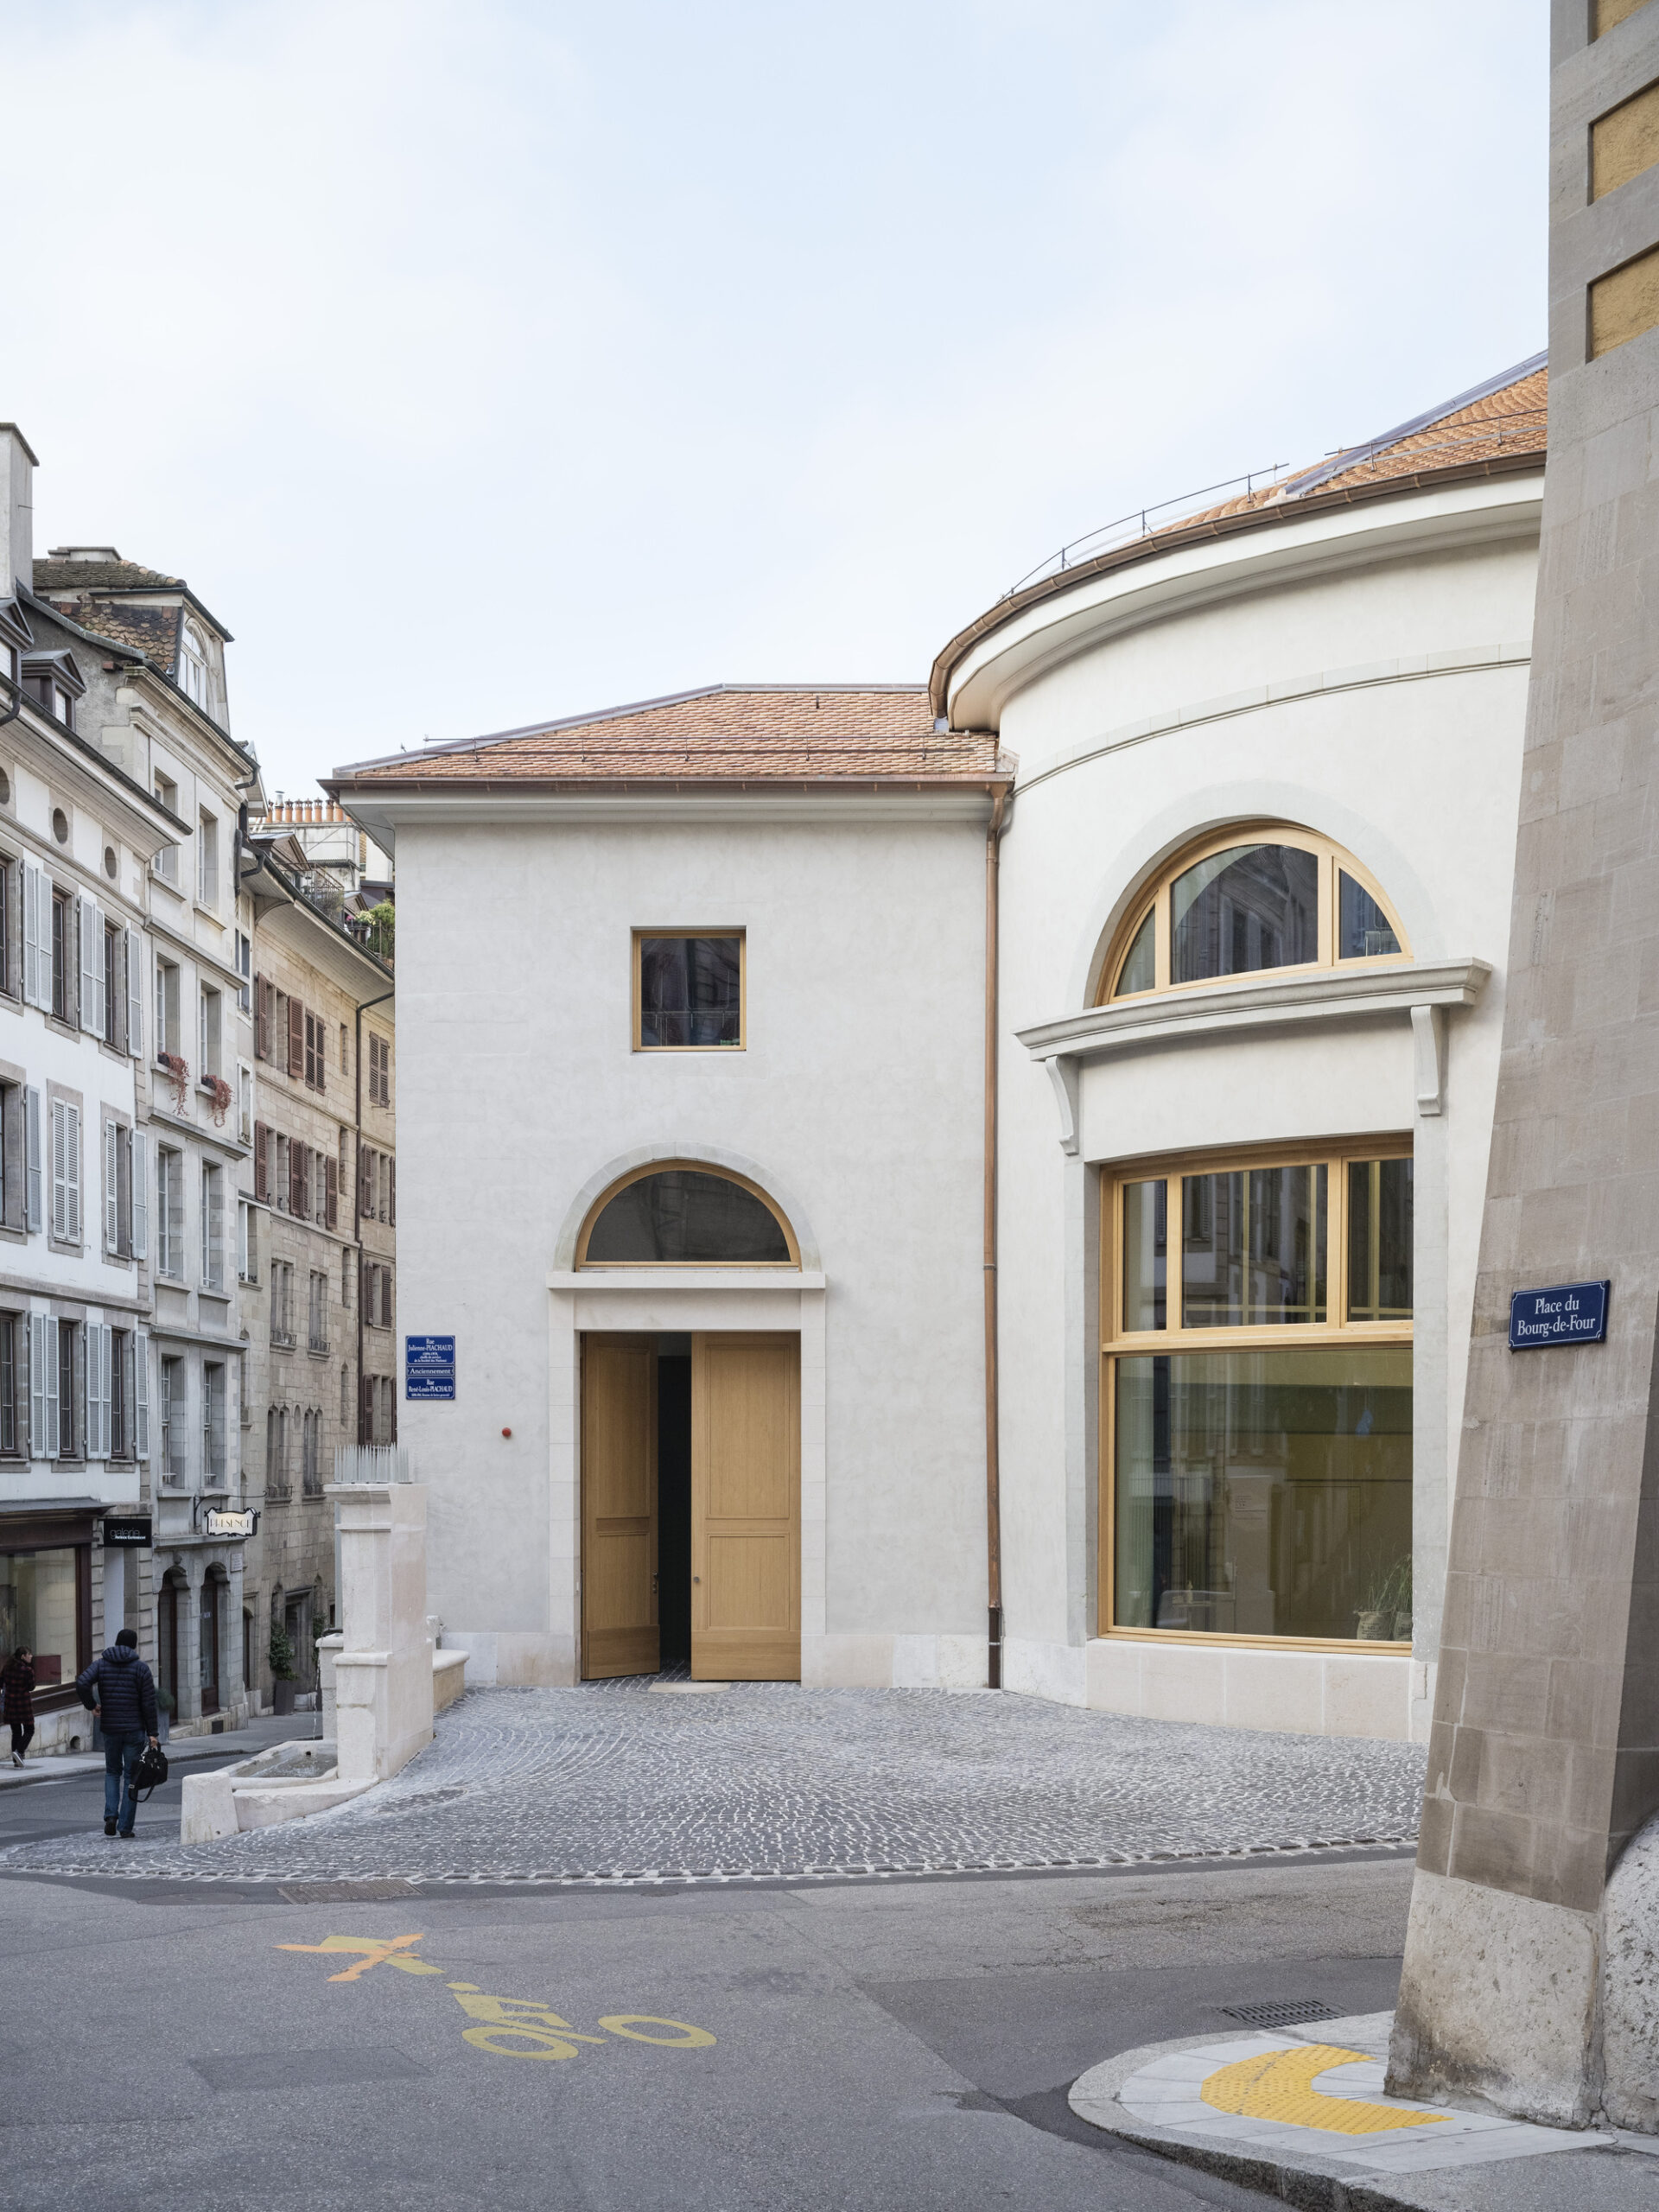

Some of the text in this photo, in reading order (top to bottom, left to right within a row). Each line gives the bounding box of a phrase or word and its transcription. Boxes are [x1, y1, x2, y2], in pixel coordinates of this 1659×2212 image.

[1535, 1294, 1580, 1314] Place du
[1517, 1314, 1595, 1338] Bourg-de-Four
[210, 1519, 250, 1528] PRESENCE
[110, 1528, 140, 1540] galerie
